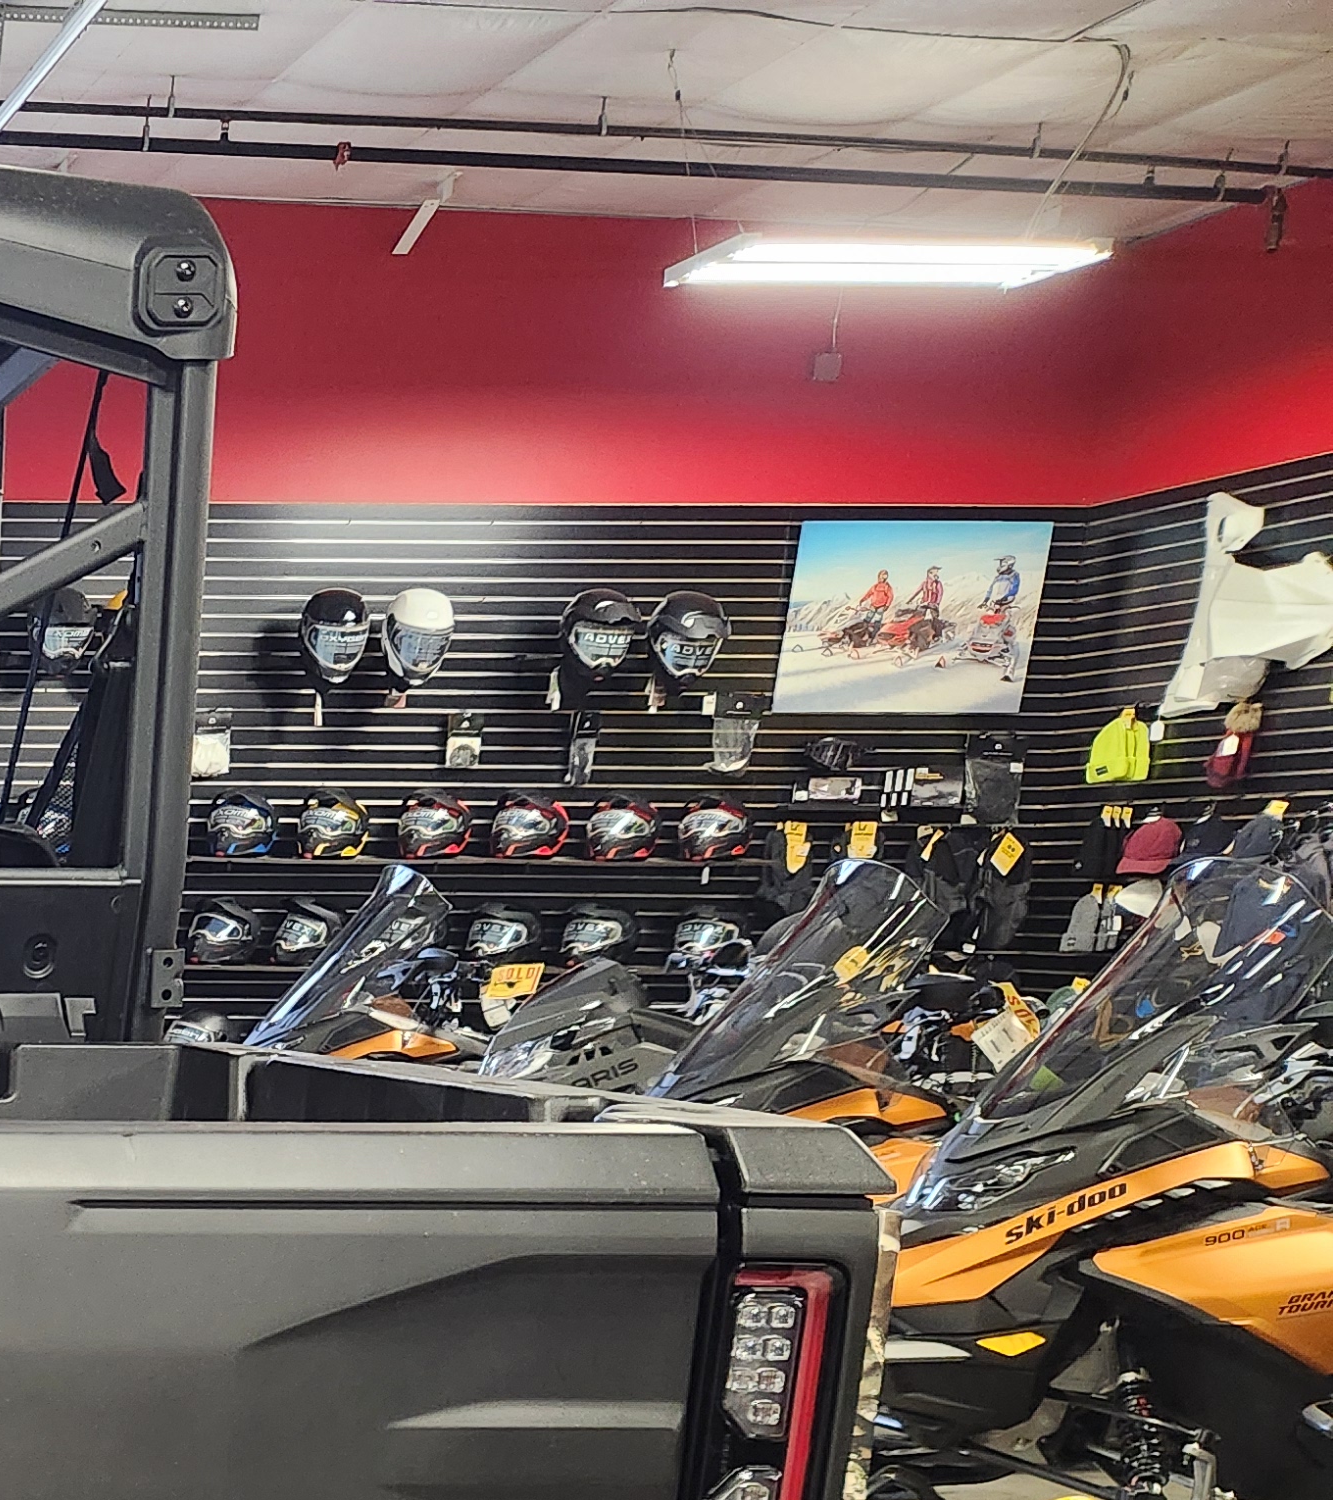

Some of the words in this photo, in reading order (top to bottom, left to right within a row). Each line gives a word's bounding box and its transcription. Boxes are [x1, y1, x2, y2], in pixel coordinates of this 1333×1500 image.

[498, 967, 534, 982] SOLD
[1004, 1182, 1127, 1245] ski-doo
[1204, 1229, 1245, 1246] 900
